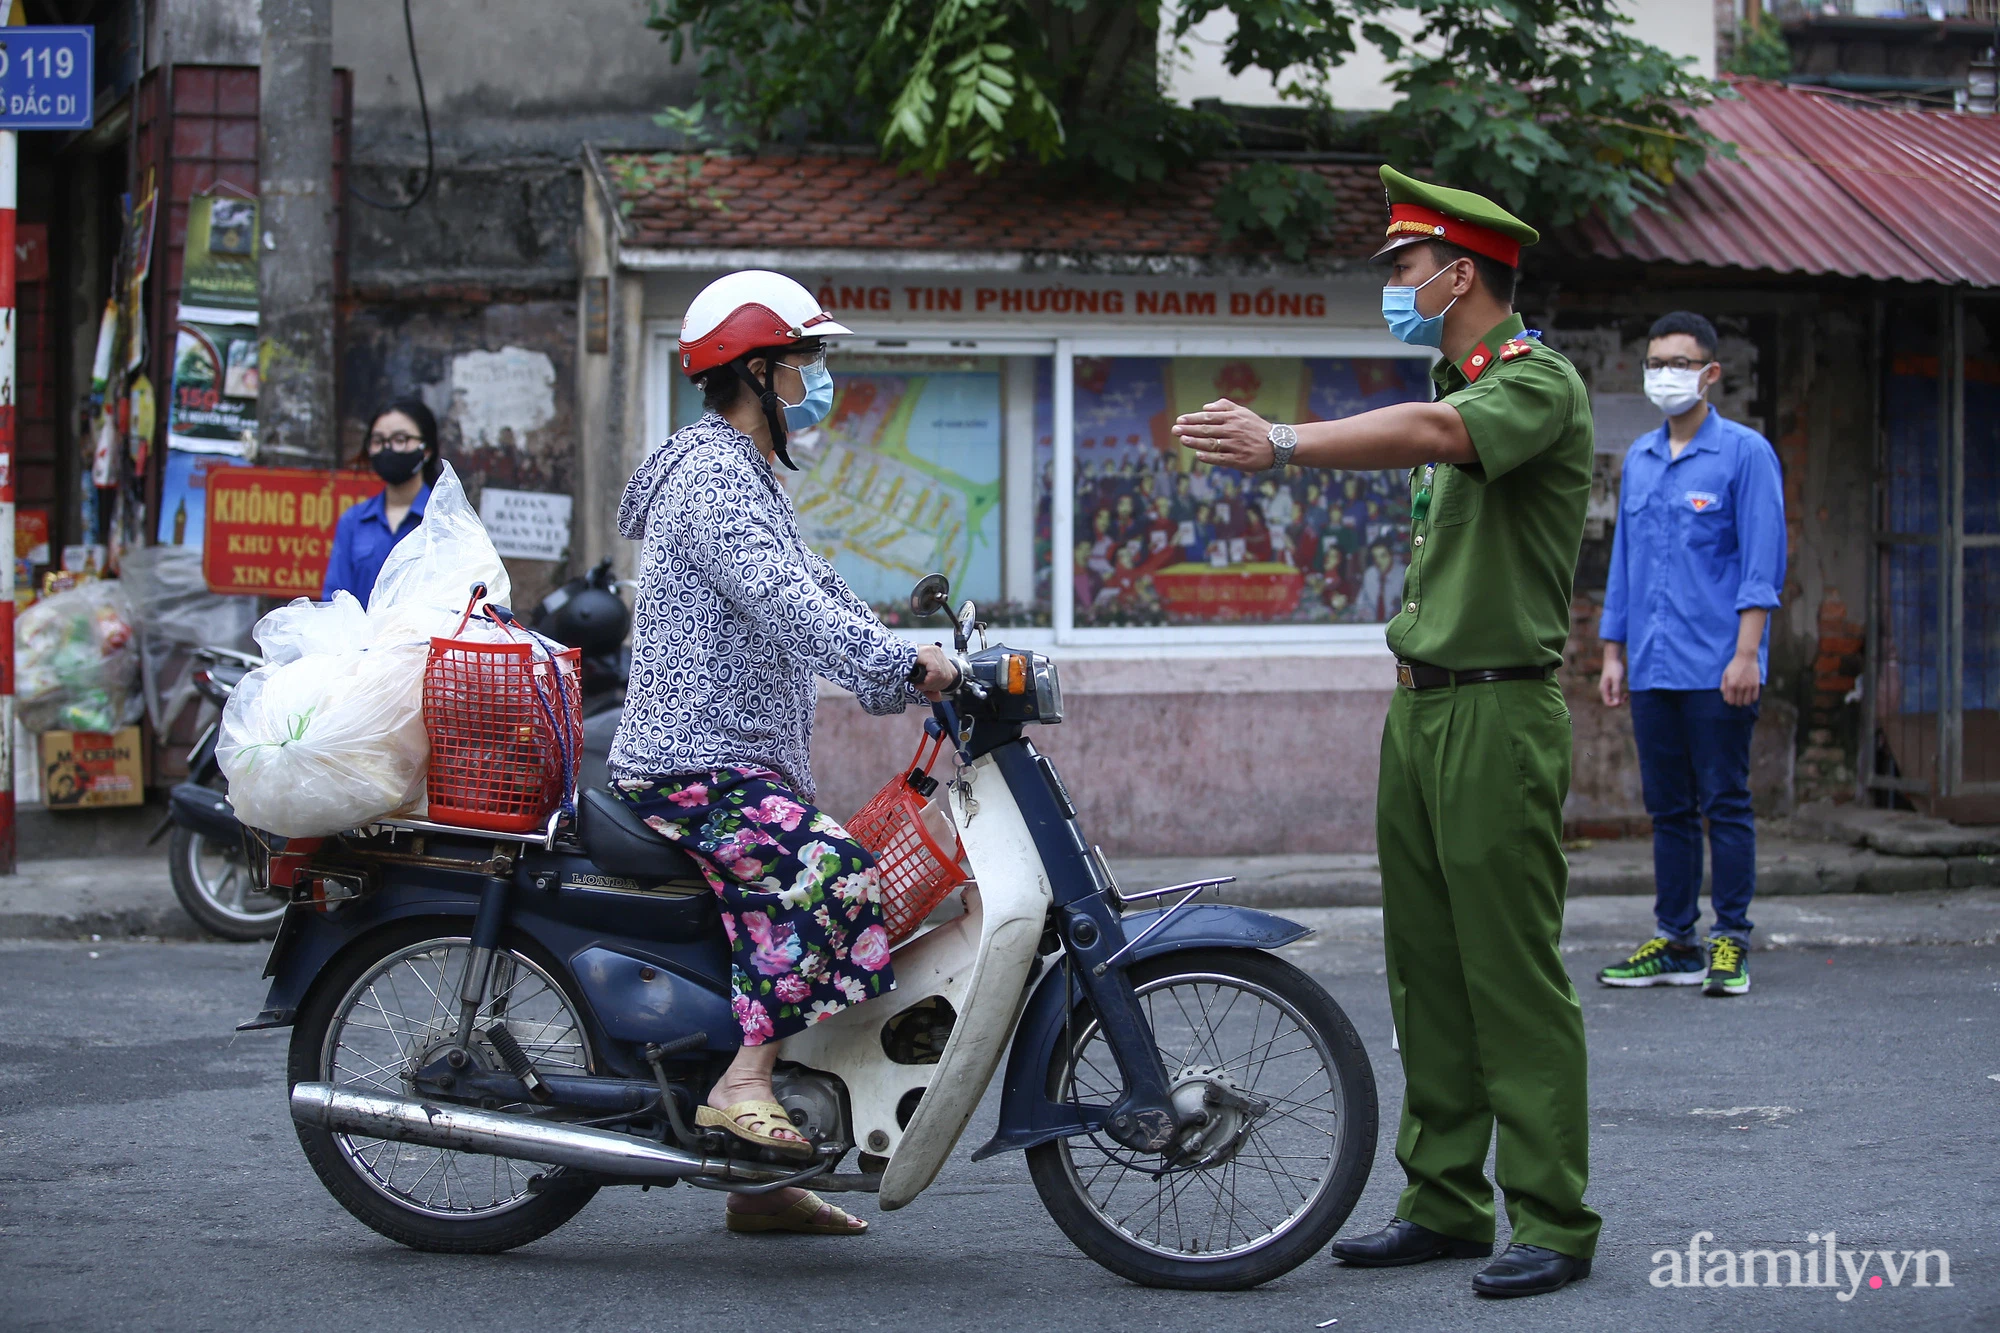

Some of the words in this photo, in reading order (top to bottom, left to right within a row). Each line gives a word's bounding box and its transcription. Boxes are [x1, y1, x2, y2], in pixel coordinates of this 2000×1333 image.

[20, 46, 74, 79] 119
[11, 84, 51, 115] ĐẮC
[57, 94, 76, 115] DI
[817, 276, 891, 311] ẢNG
[904, 286, 963, 312] TIN
[975, 281, 1124, 314] PHƯỜNG
[1134, 290, 1217, 316] NAM
[214, 482, 296, 526] KHÔNG
[228, 534, 273, 556] KHU
[277, 533, 321, 560] VỰC
[232, 566, 270, 586] XIN
[572, 873, 639, 889] HONDA
